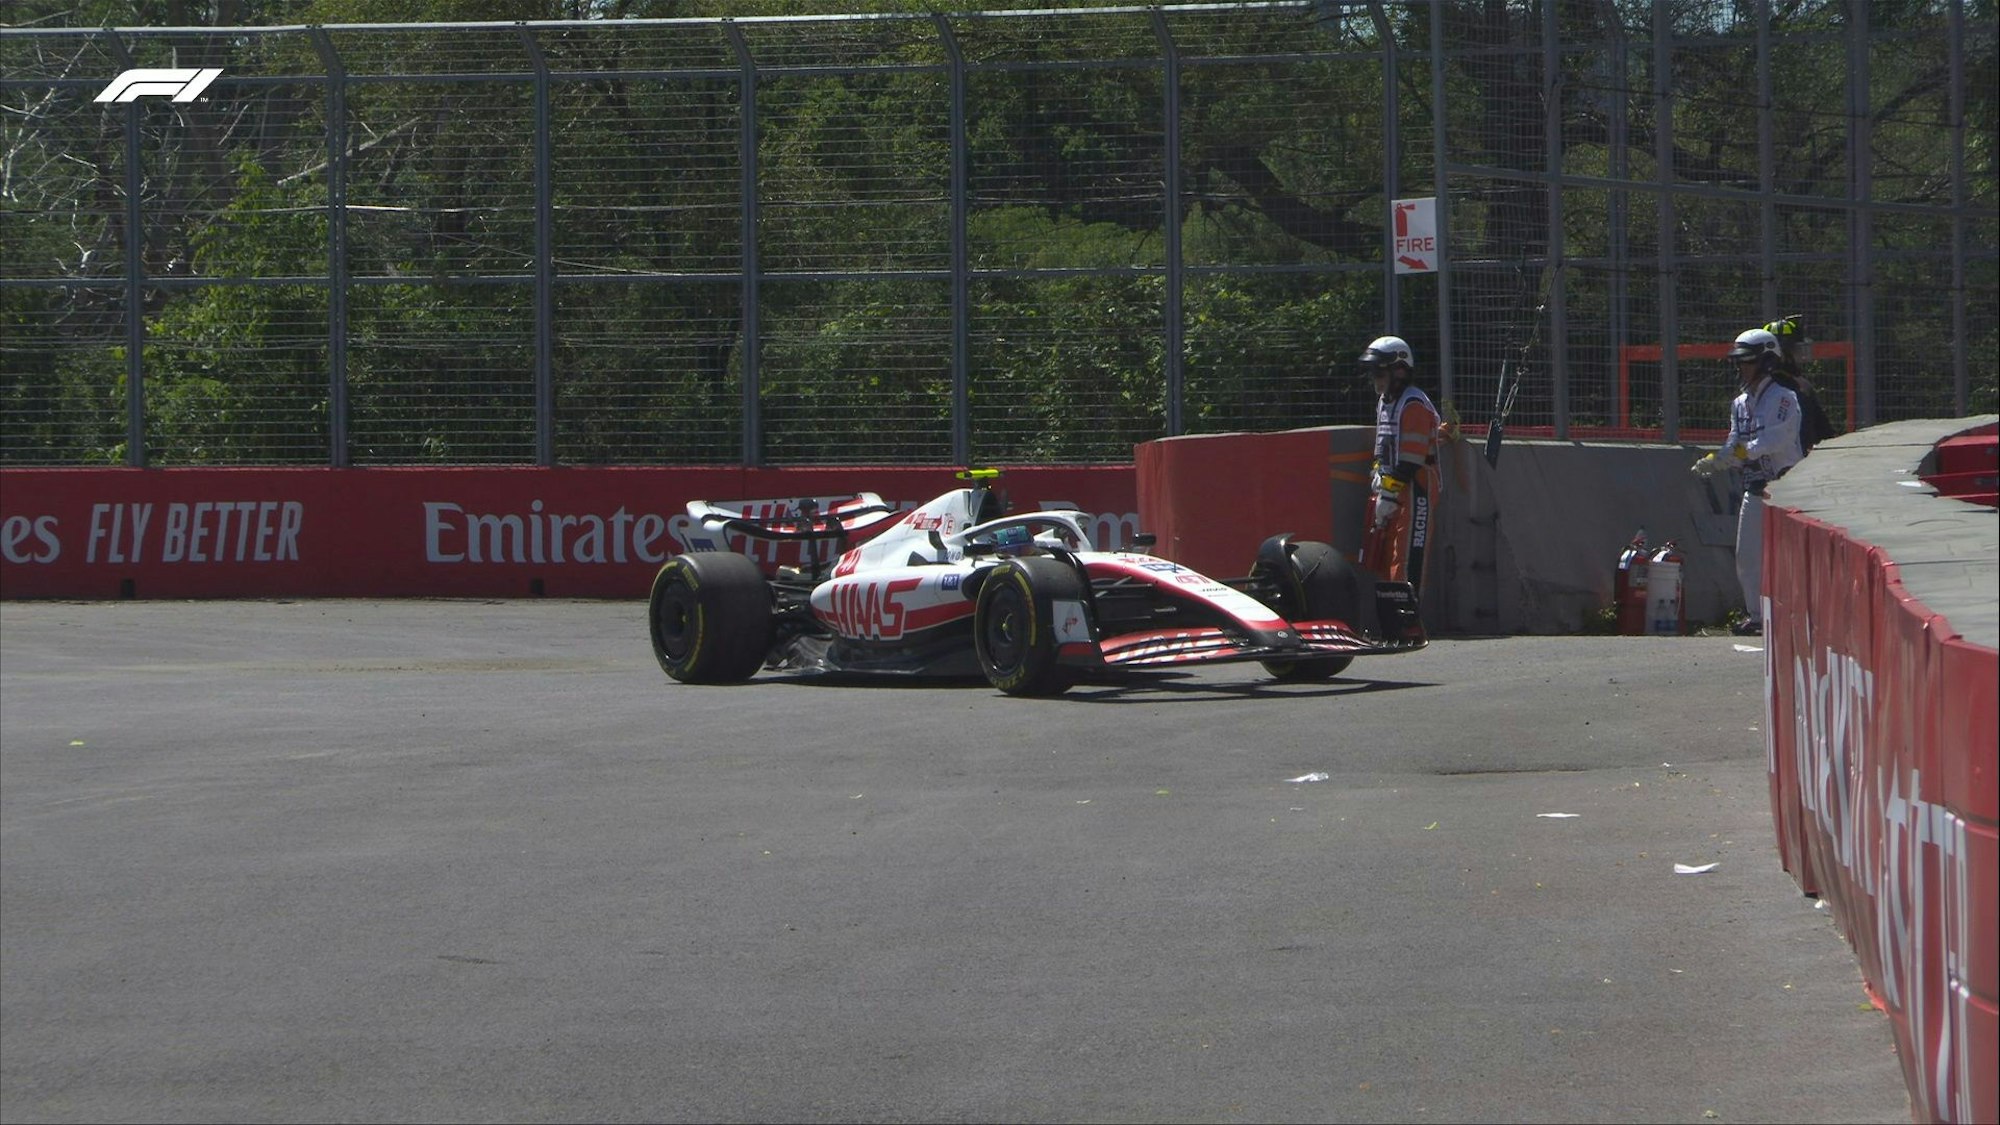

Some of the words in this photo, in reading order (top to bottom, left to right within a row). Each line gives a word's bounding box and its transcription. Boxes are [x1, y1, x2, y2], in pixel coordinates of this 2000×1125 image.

[1396, 236, 1435, 254] FIRE
[86, 503, 152, 563] FLY
[162, 501, 304, 563] BETTER
[423, 499, 694, 564] Emirates
[1413, 496, 1427, 548] RACING
[829, 577, 924, 640] HAAS
